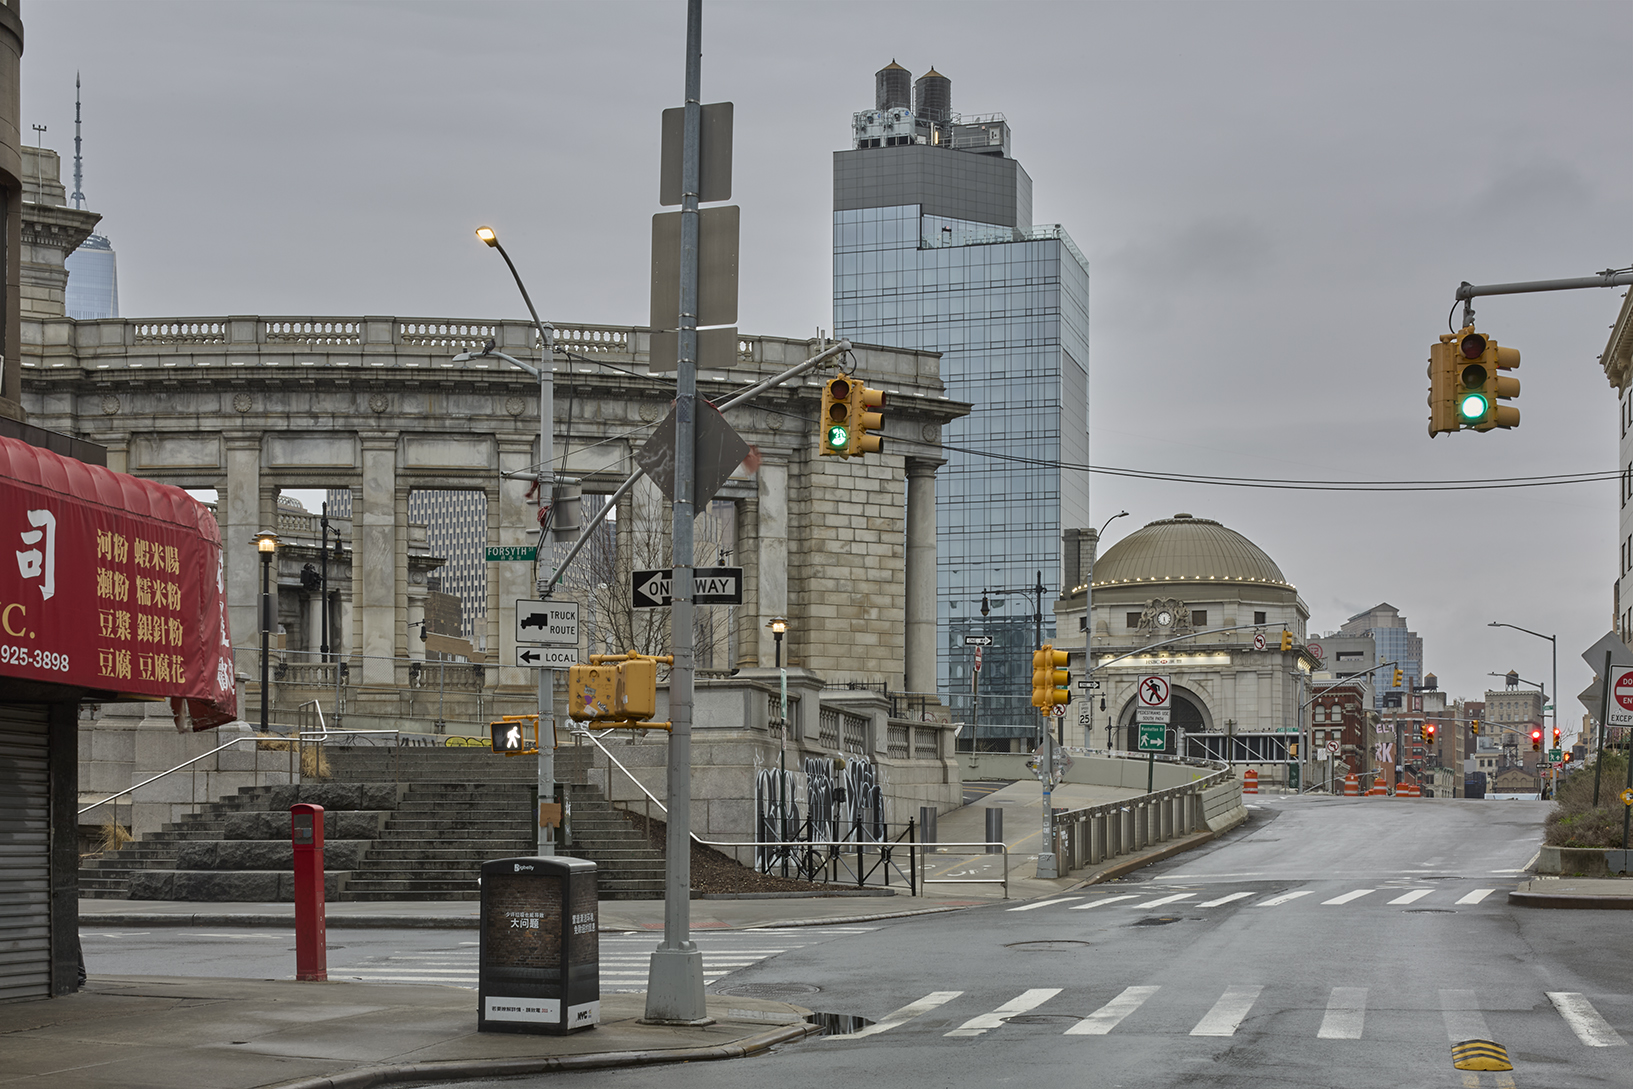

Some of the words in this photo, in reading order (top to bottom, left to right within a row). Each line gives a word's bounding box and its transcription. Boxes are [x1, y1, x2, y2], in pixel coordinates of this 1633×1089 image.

[16, 508, 56, 601] 司
[97, 529, 128, 564] 河粉
[135, 537, 180, 575] 蝦米腸
[487, 547, 527, 556] FORSYTH
[136, 575, 181, 611] 糯米粉
[649, 580, 673, 596] ON
[695, 579, 729, 593] WAY
[550, 611, 576, 620] TRUCK
[98, 609, 131, 641] 豆漿
[137, 612, 183, 647] 銀針粉
[550, 625, 576, 635] ROUTE
[1, 644, 70, 672] 925-3898
[545, 653, 576, 663] LOCAL
[98, 648, 131, 680] 豆腐
[138, 652, 186, 684] 豆腐花
[1079, 714, 1090, 724] 25
[510, 918, 540, 929] 大问题
[577, 1010, 587, 1021] NYC
